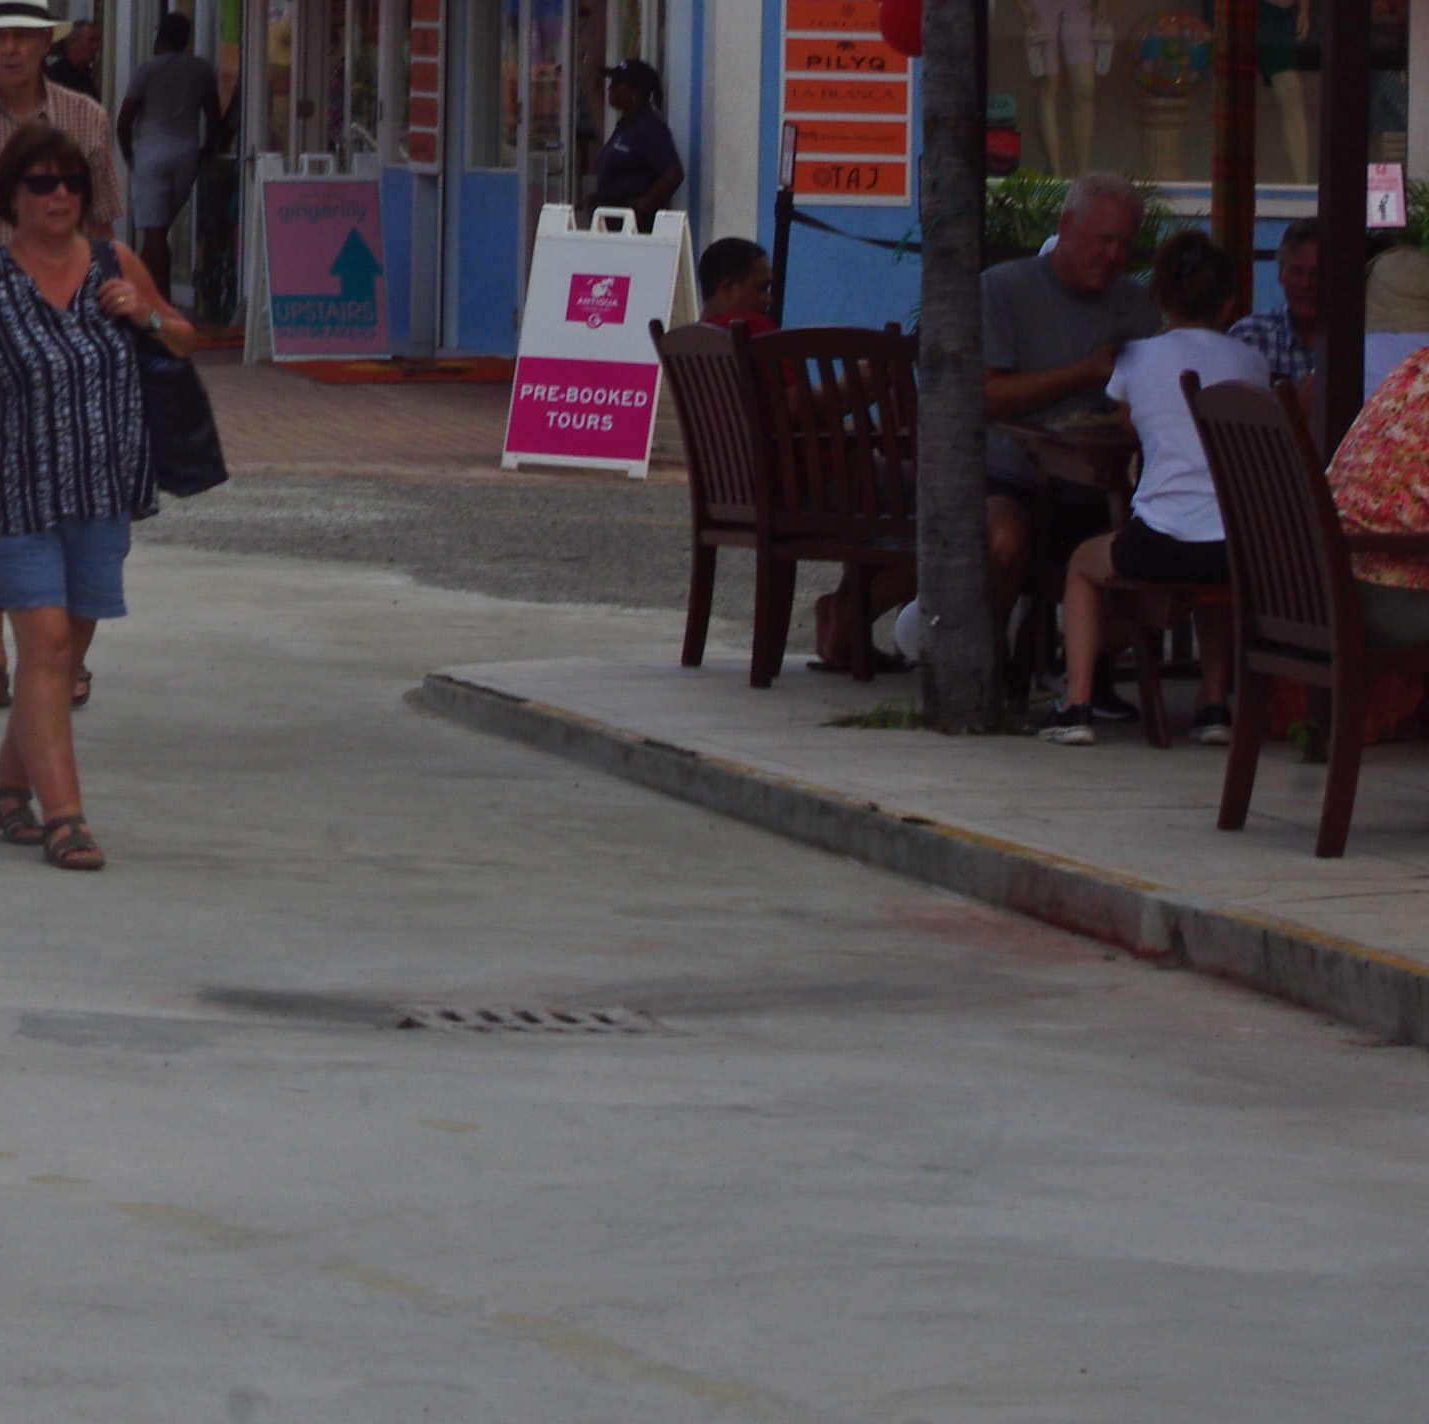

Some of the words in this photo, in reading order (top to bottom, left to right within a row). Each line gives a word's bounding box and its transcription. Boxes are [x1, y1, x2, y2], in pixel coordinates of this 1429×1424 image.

[807, 55, 887, 71] PILYQ
[831, 166, 880, 190] TAJ
[275, 302, 376, 323] UPSTAIRS
[520, 383, 648, 408] PRE-BOOKED
[546, 411, 614, 431] TOURS
